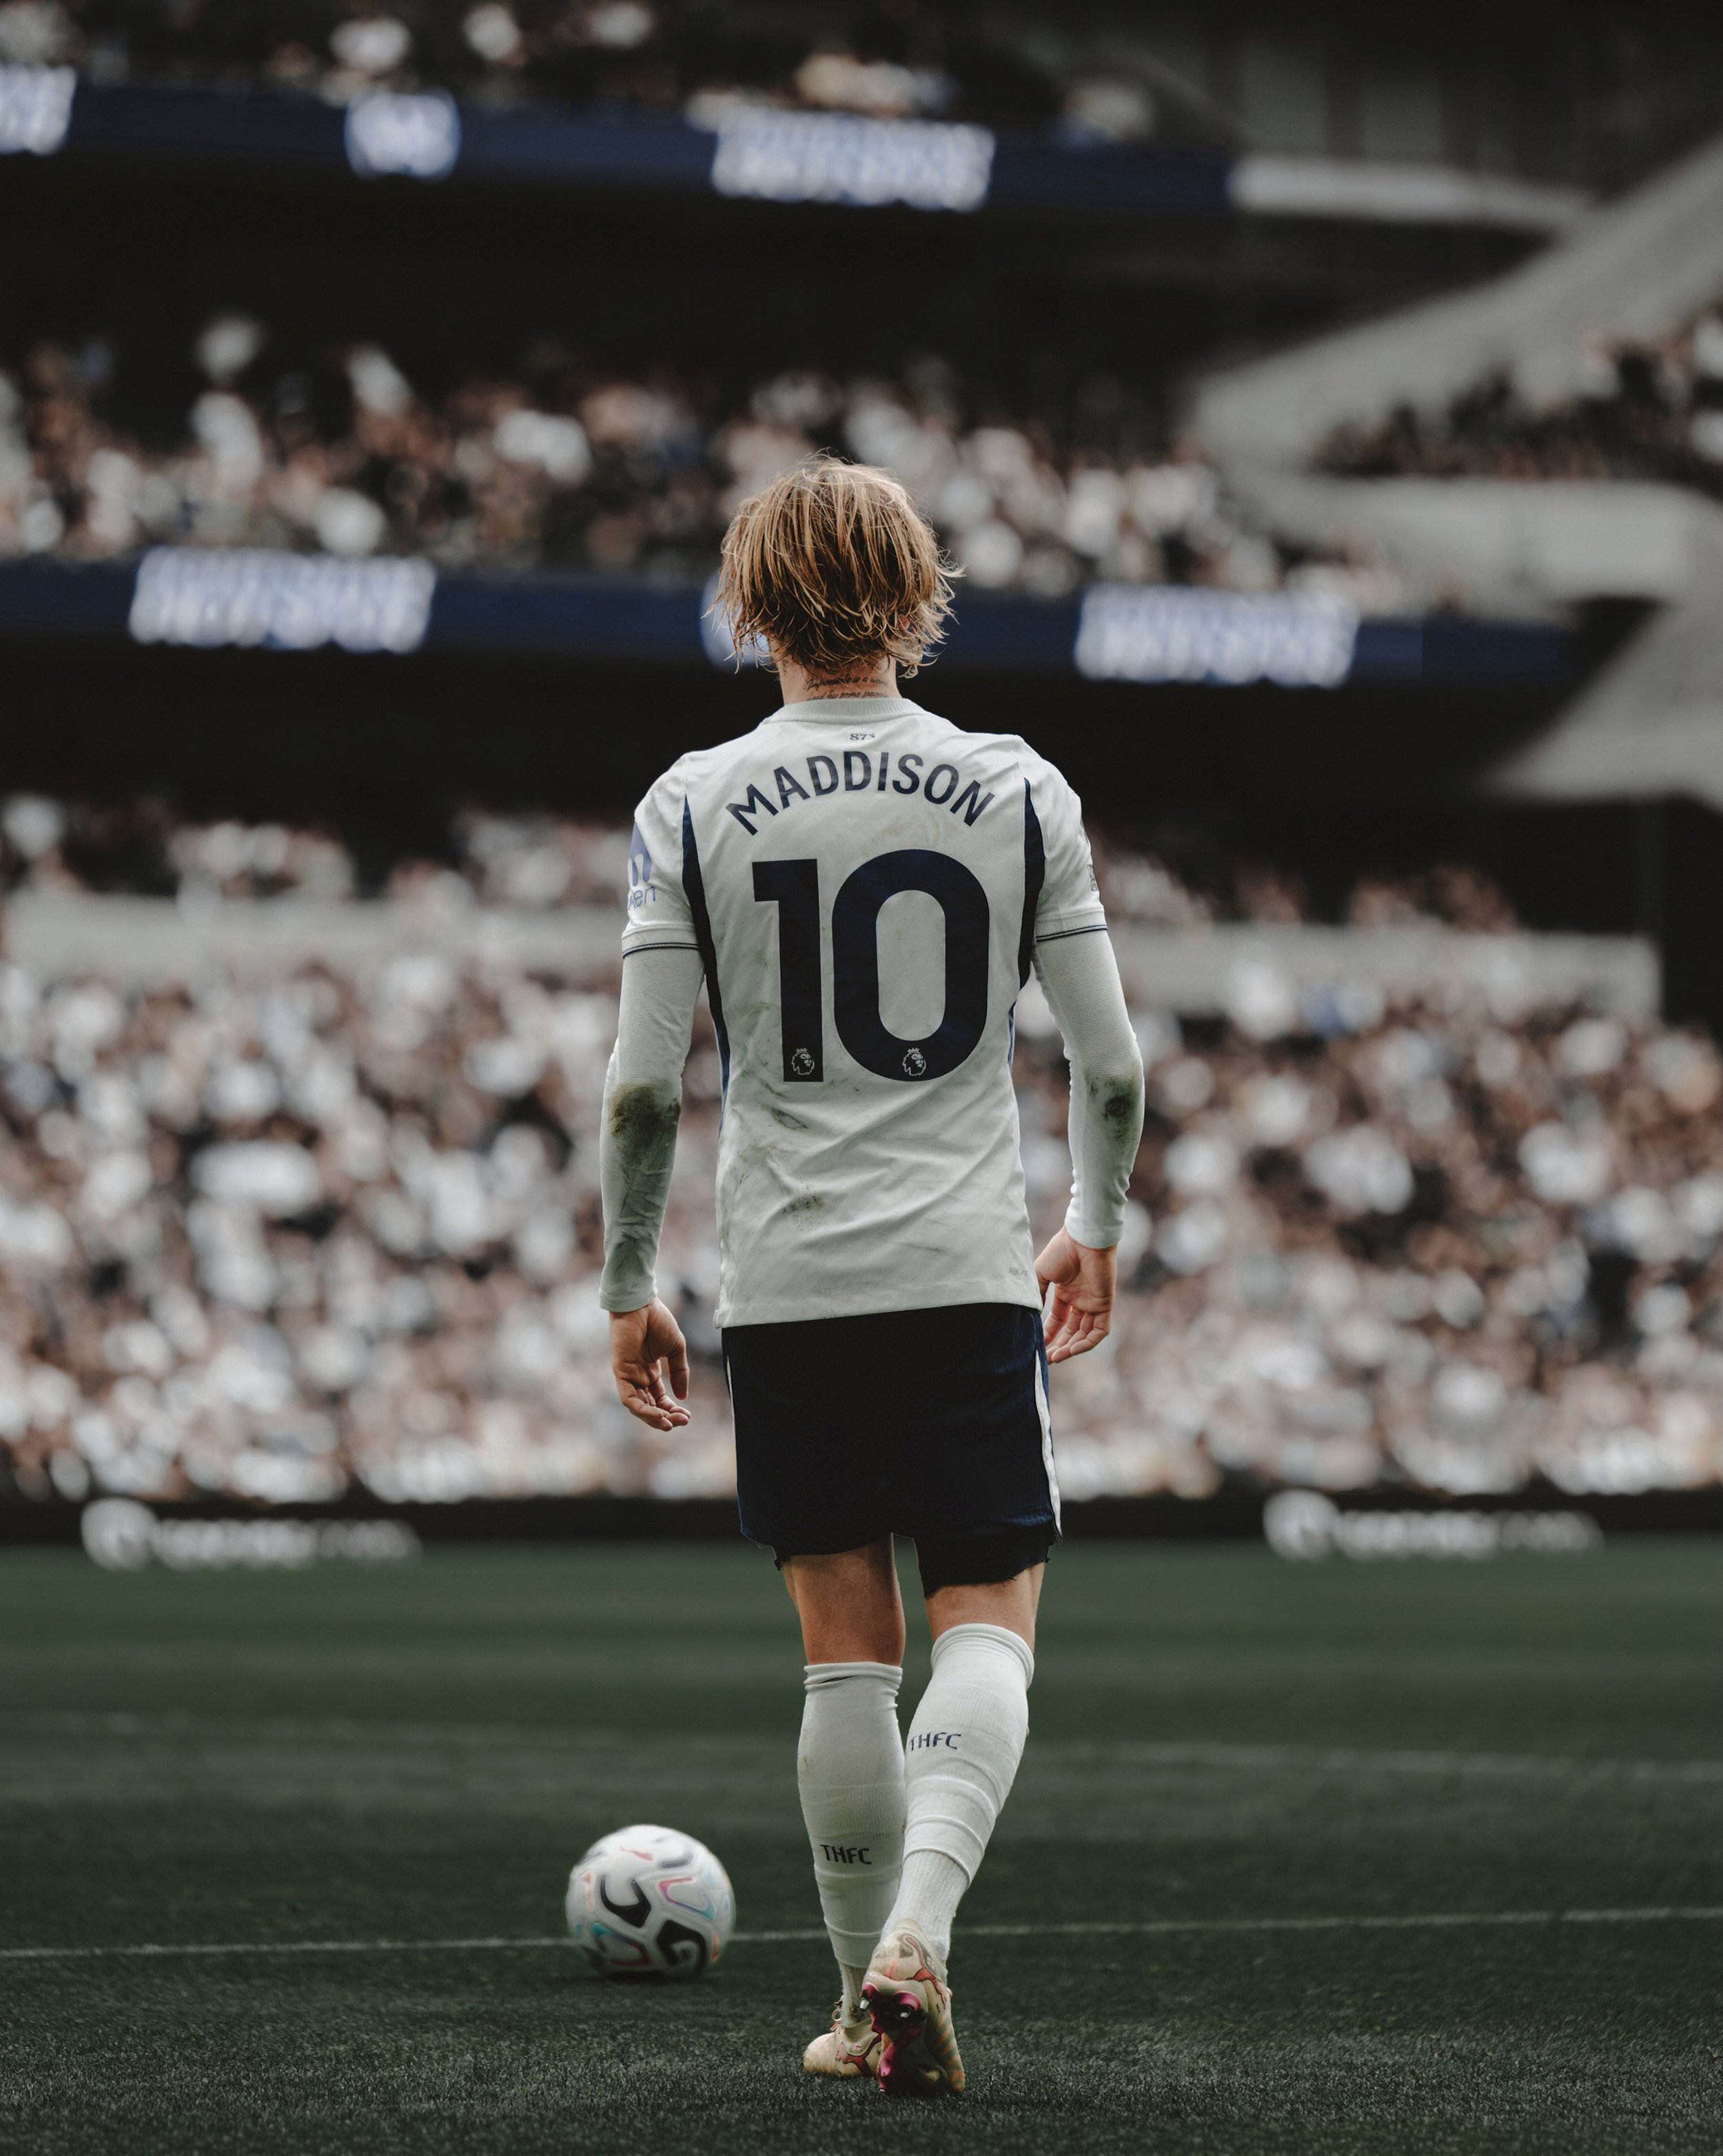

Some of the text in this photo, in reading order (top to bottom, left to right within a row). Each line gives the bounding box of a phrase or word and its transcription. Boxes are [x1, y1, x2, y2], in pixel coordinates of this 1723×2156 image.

[726, 751, 994, 835] MADDISON
[751, 849, 990, 1082] 10
[909, 1732, 961, 1751] THFC
[820, 1844, 872, 1865] THFC
